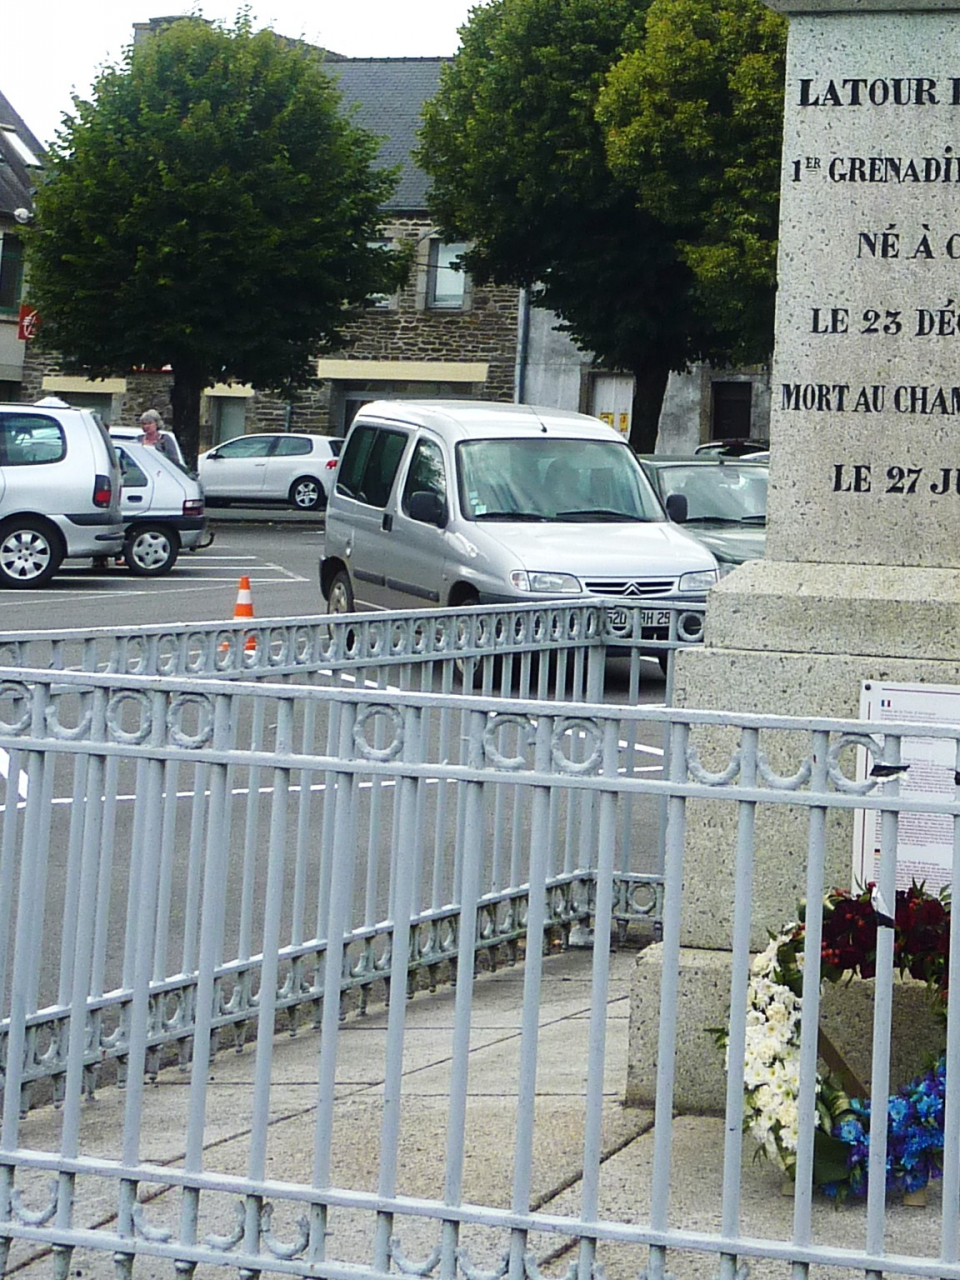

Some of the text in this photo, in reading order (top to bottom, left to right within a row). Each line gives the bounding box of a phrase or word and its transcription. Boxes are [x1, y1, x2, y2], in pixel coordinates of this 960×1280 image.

[797, 77, 941, 107] LATOUR
[857, 223, 900, 259] NÉ
[910, 223, 936, 261] À
[810, 308, 849, 334] LE
[860, 309, 902, 335] 23
[781, 383, 850, 412] MORT
[852, 384, 887, 413] AU
[832, 464, 871, 493] LE
[885, 466, 924, 494] 27
